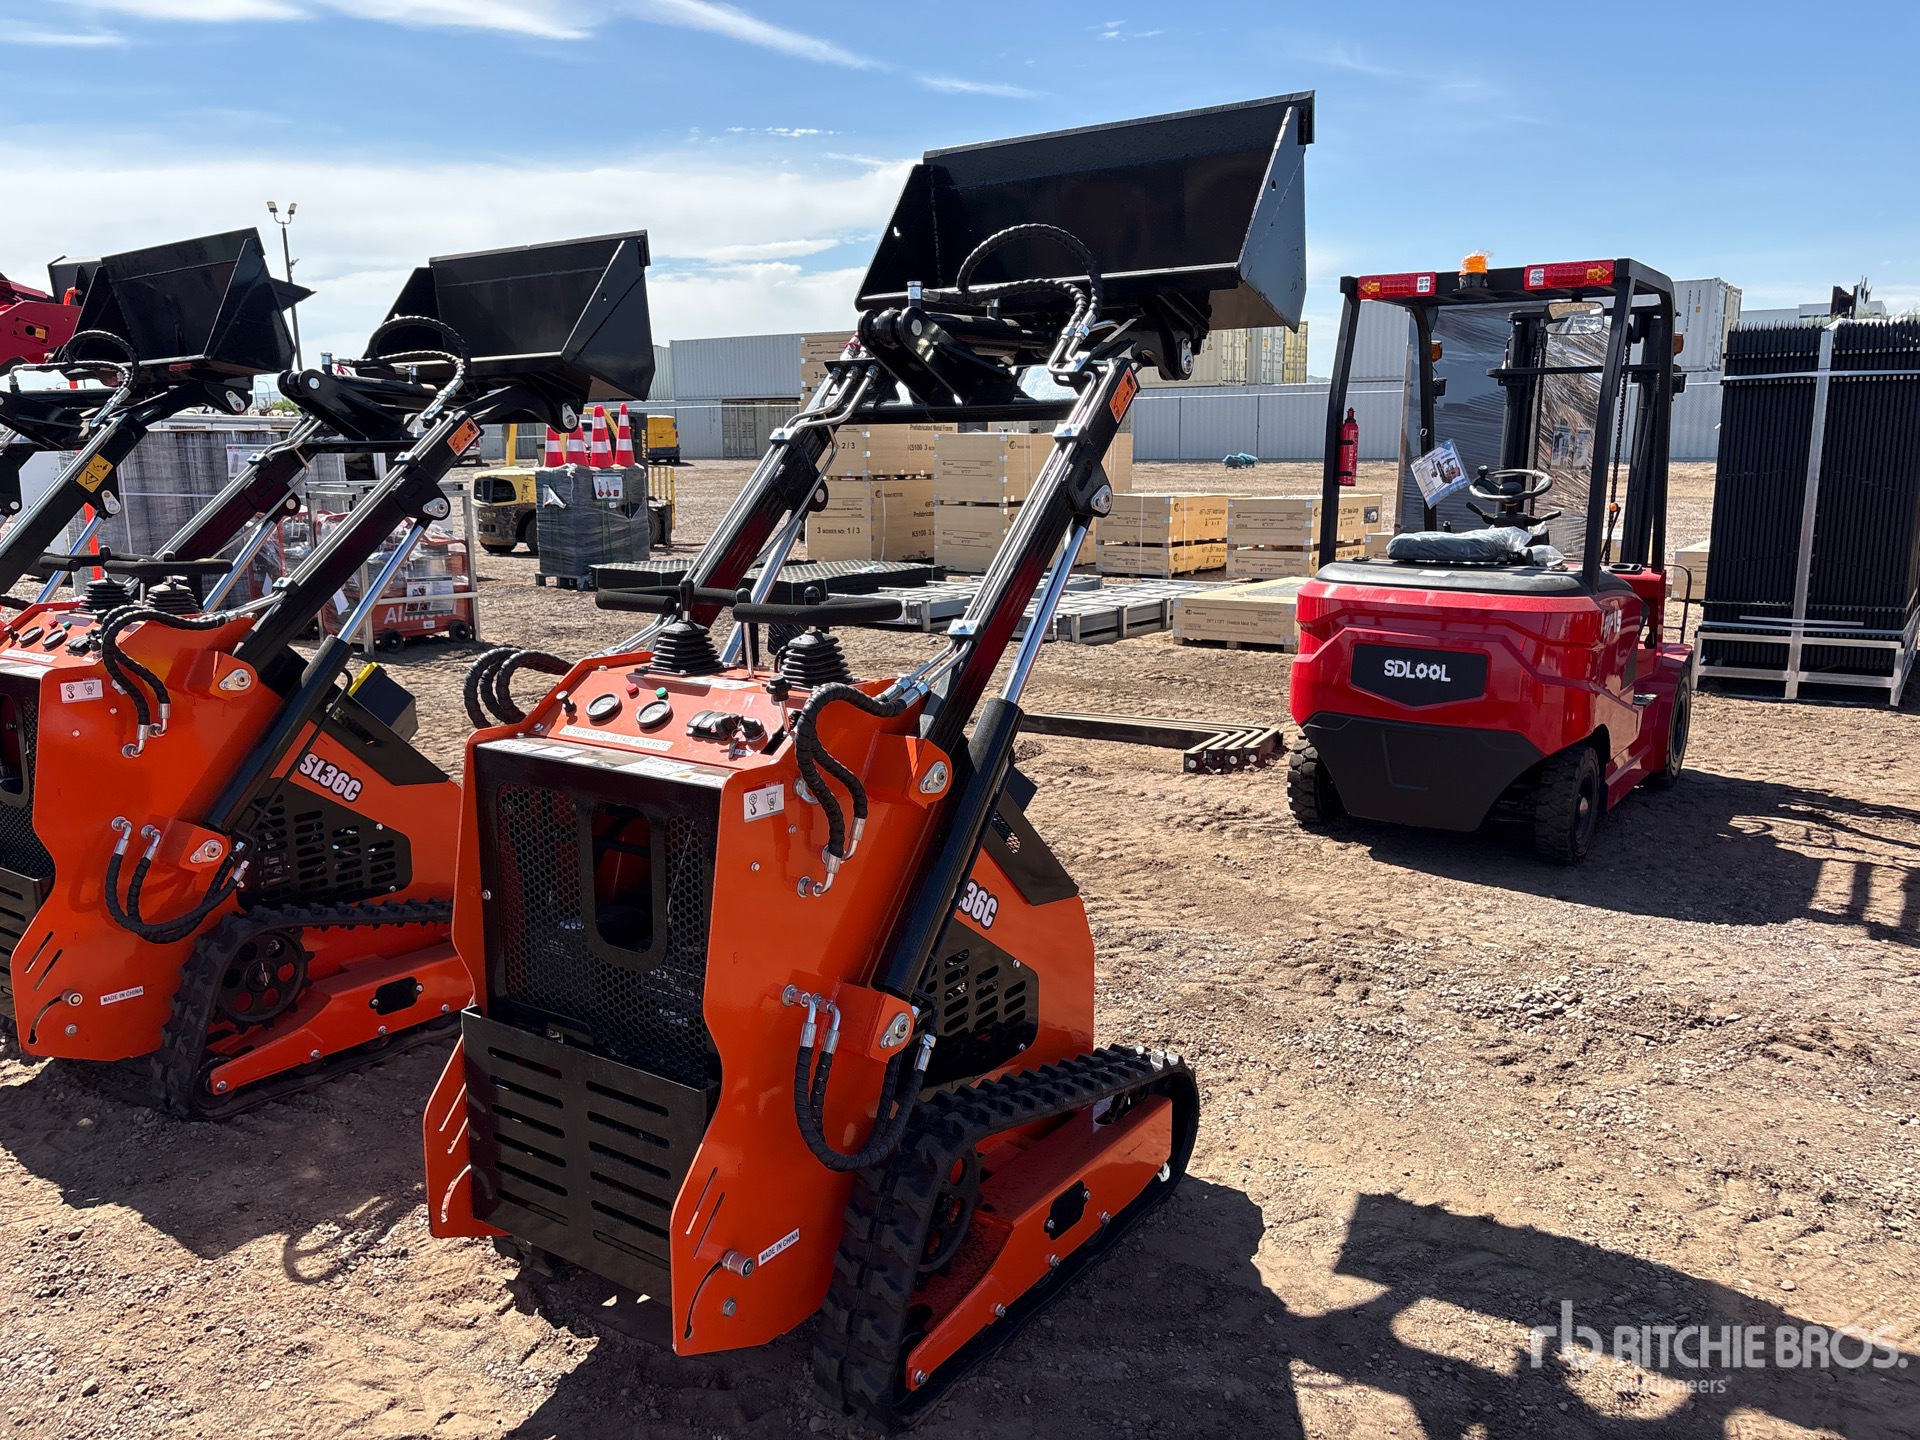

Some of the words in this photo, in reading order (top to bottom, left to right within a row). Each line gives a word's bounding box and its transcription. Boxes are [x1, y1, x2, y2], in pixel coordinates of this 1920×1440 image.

[1383, 659, 1451, 682] SDLOOL
[299, 752, 363, 802] SL36C
[103, 993, 118, 1003] MADE
[125, 987, 143, 997] CHINA
[761, 1246, 776, 1262] MADE
[776, 1241, 783, 1252] IN
[782, 1231, 799, 1247] CHINA
